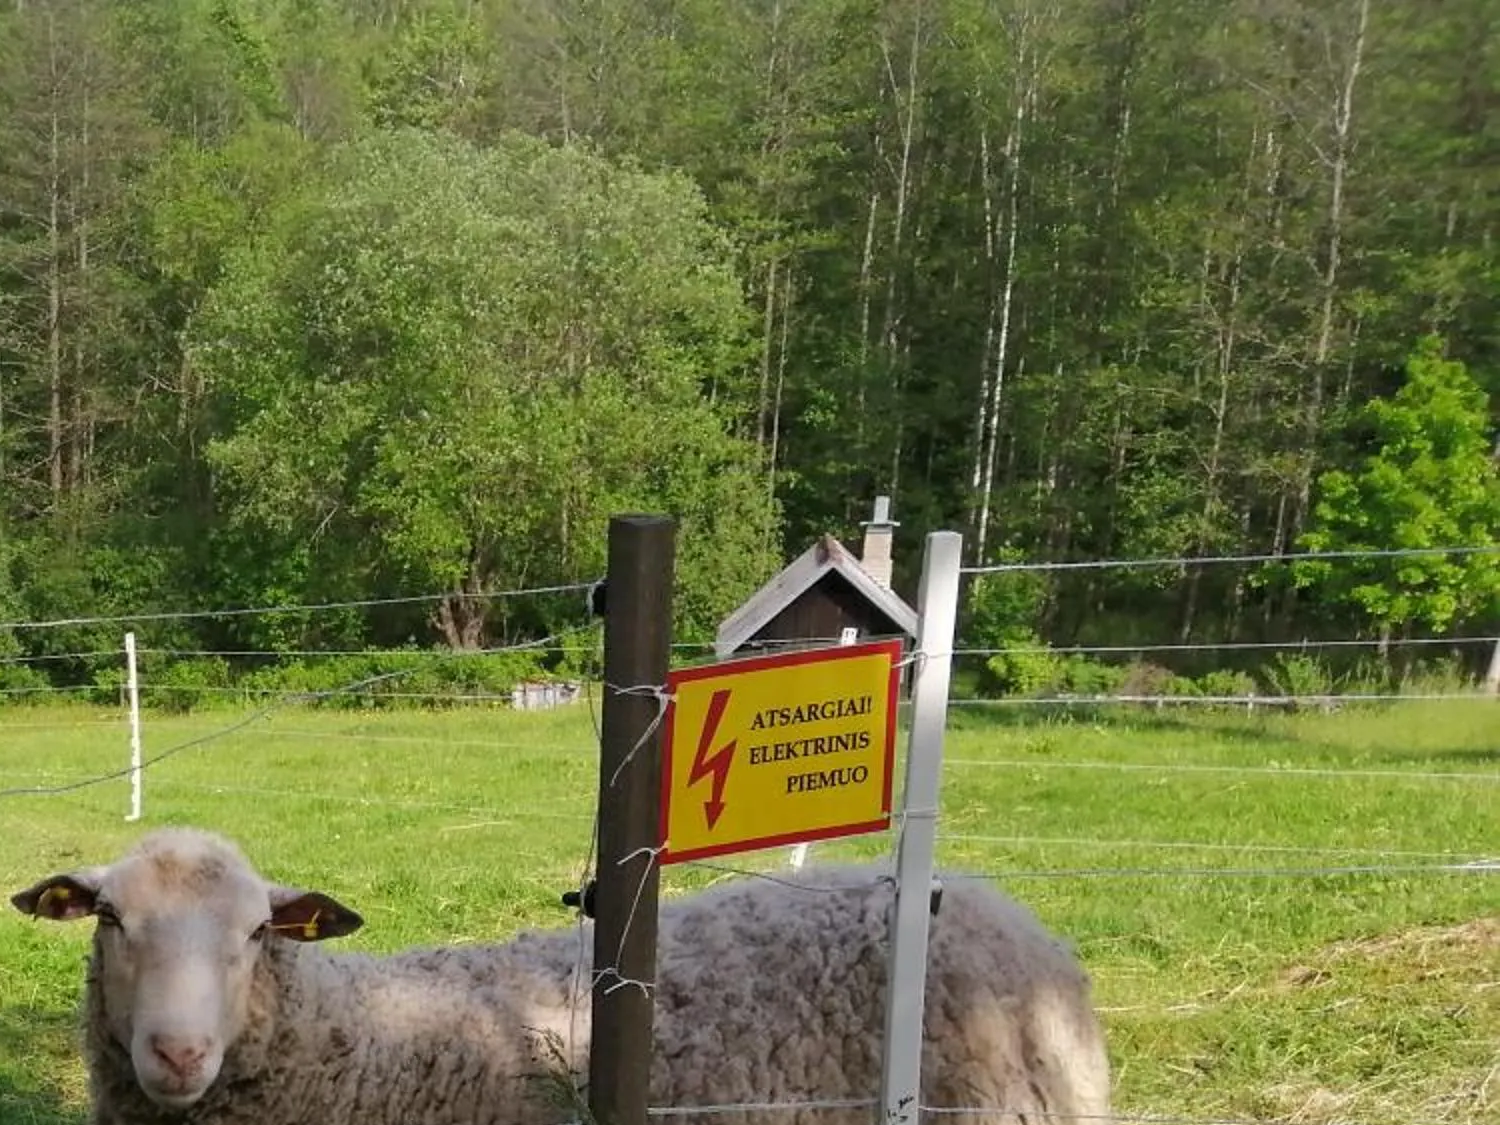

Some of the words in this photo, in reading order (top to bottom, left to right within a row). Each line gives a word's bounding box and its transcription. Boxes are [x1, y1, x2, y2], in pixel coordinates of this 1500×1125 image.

[750, 696, 872, 731] ATSARGIAI!
[749, 731, 870, 765] ELEKTRINIS
[786, 765, 869, 795] PIEMUO
